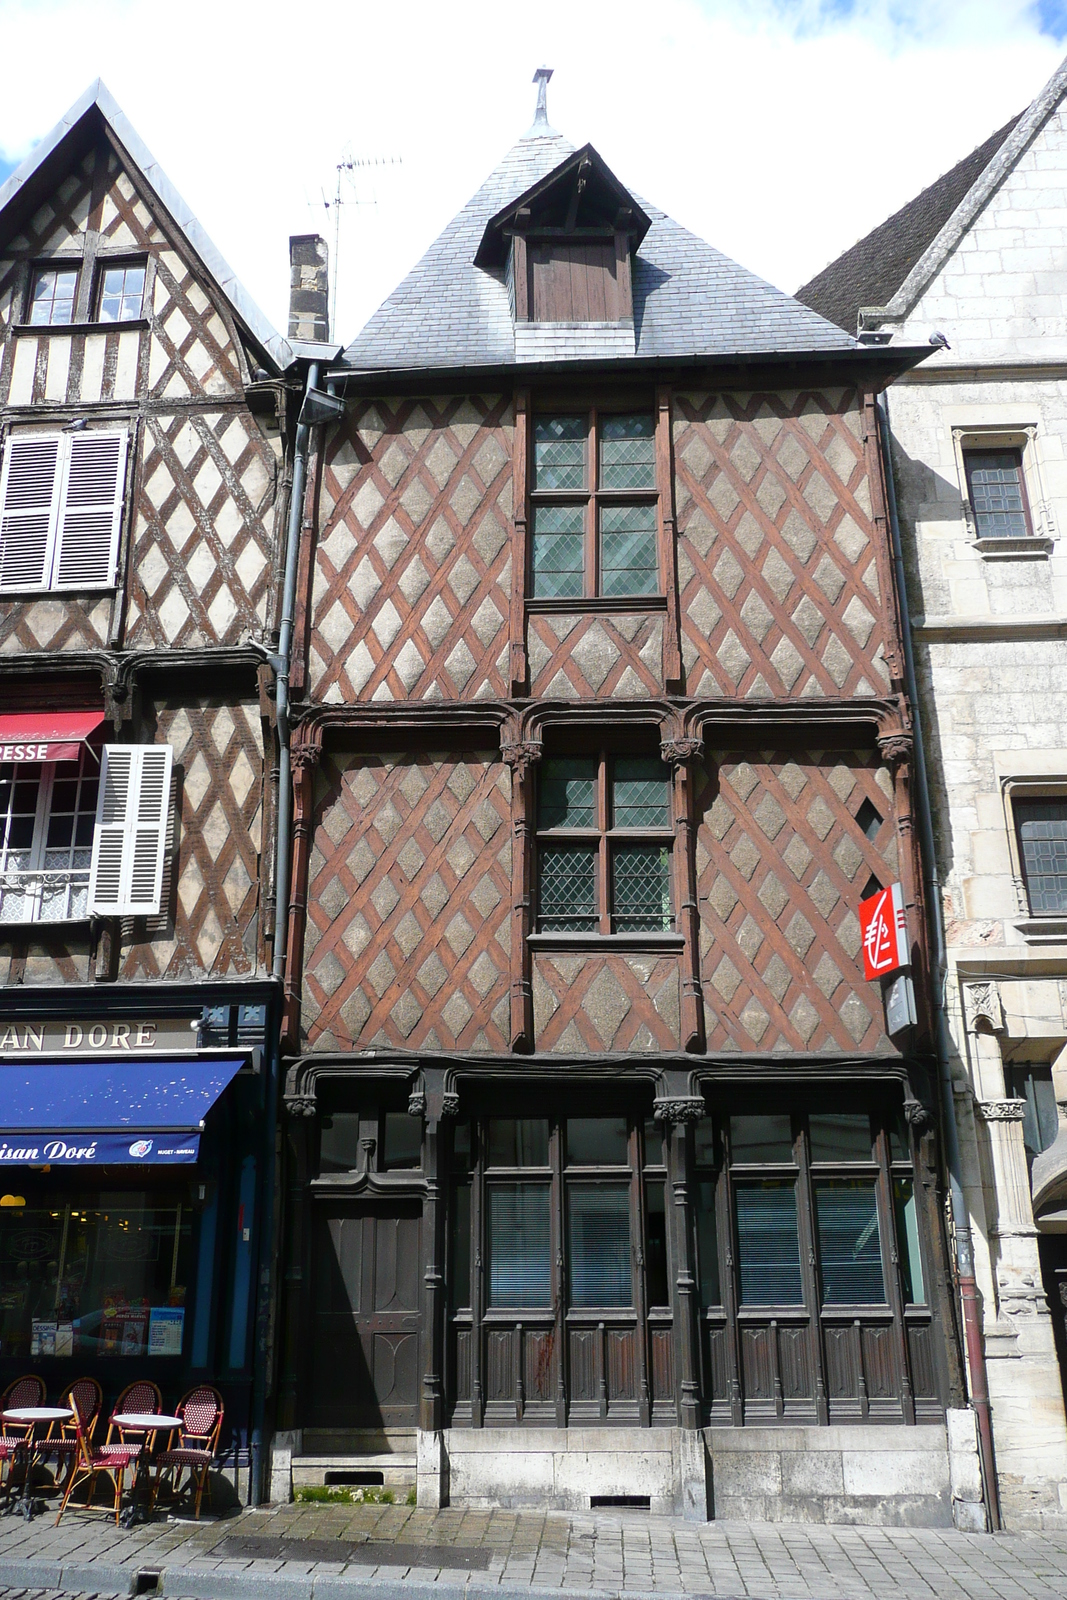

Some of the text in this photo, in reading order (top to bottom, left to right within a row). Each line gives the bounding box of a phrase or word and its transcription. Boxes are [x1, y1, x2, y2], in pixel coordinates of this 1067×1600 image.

[0, 745, 48, 760] ESSE
[63, 1021, 158, 1049] DORÉ
[43, 1141, 97, 1159] Doré
